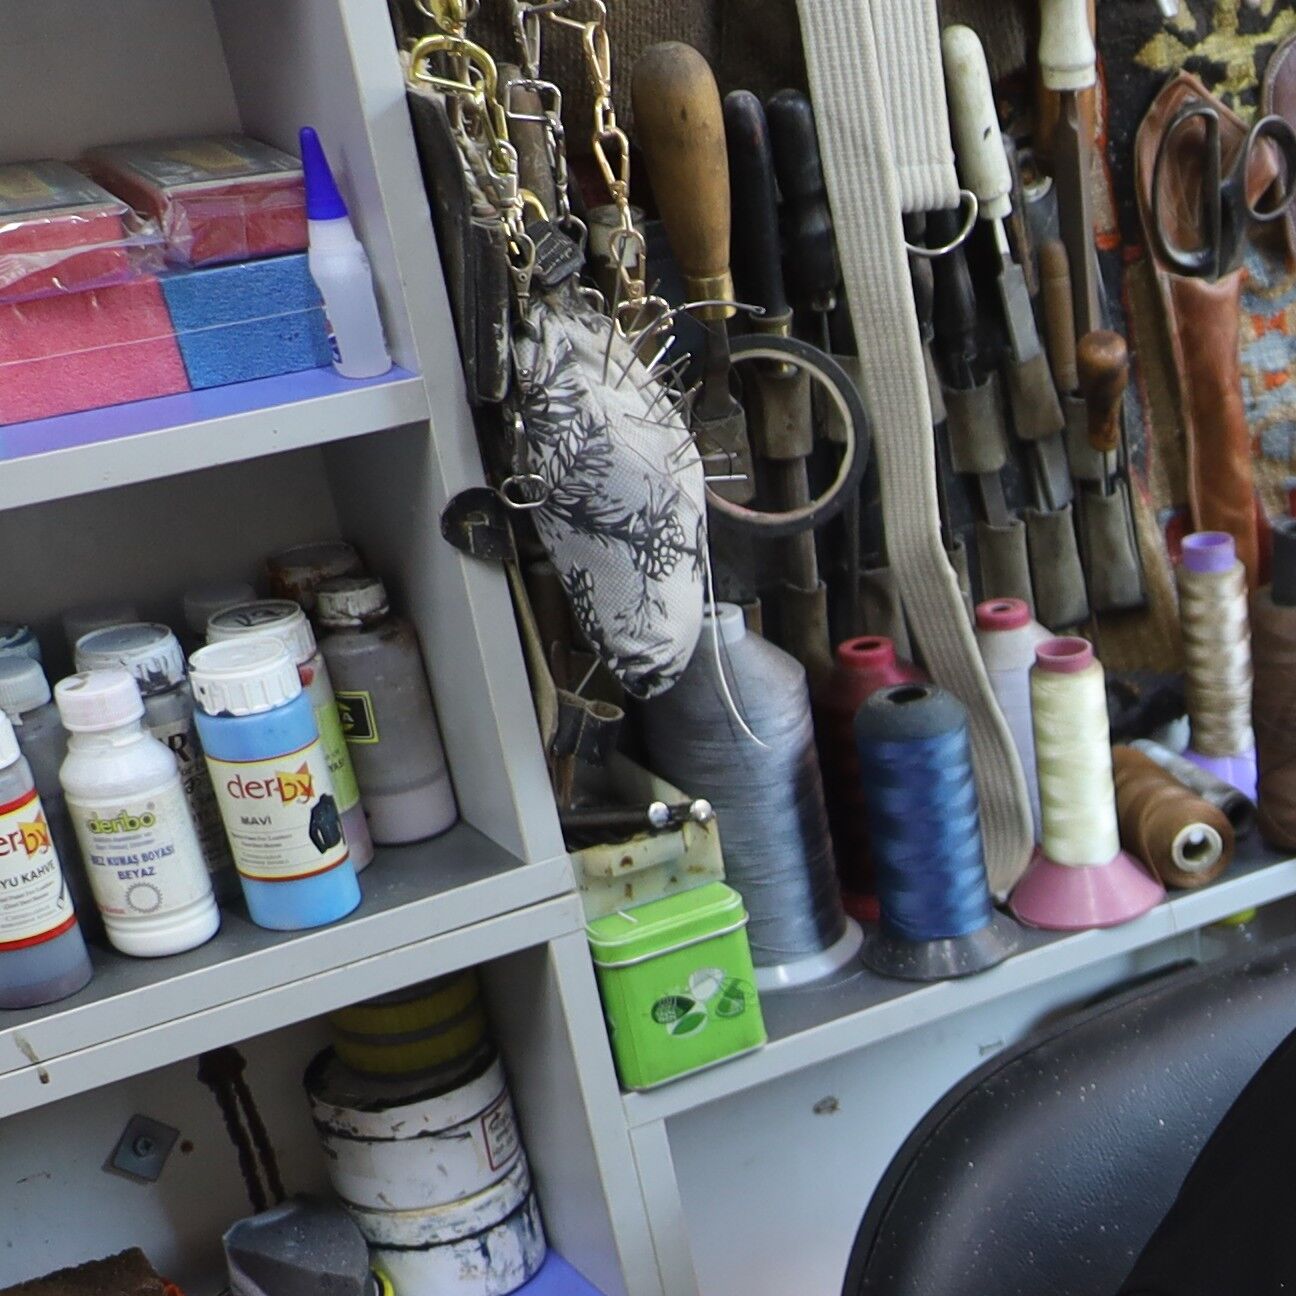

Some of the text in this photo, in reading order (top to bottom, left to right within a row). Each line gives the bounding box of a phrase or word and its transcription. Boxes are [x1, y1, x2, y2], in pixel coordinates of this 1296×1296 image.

[227, 774, 313, 804] derby
[22, 859, 55, 883] KAHVE
[117, 866, 156, 880] BEYAZ
